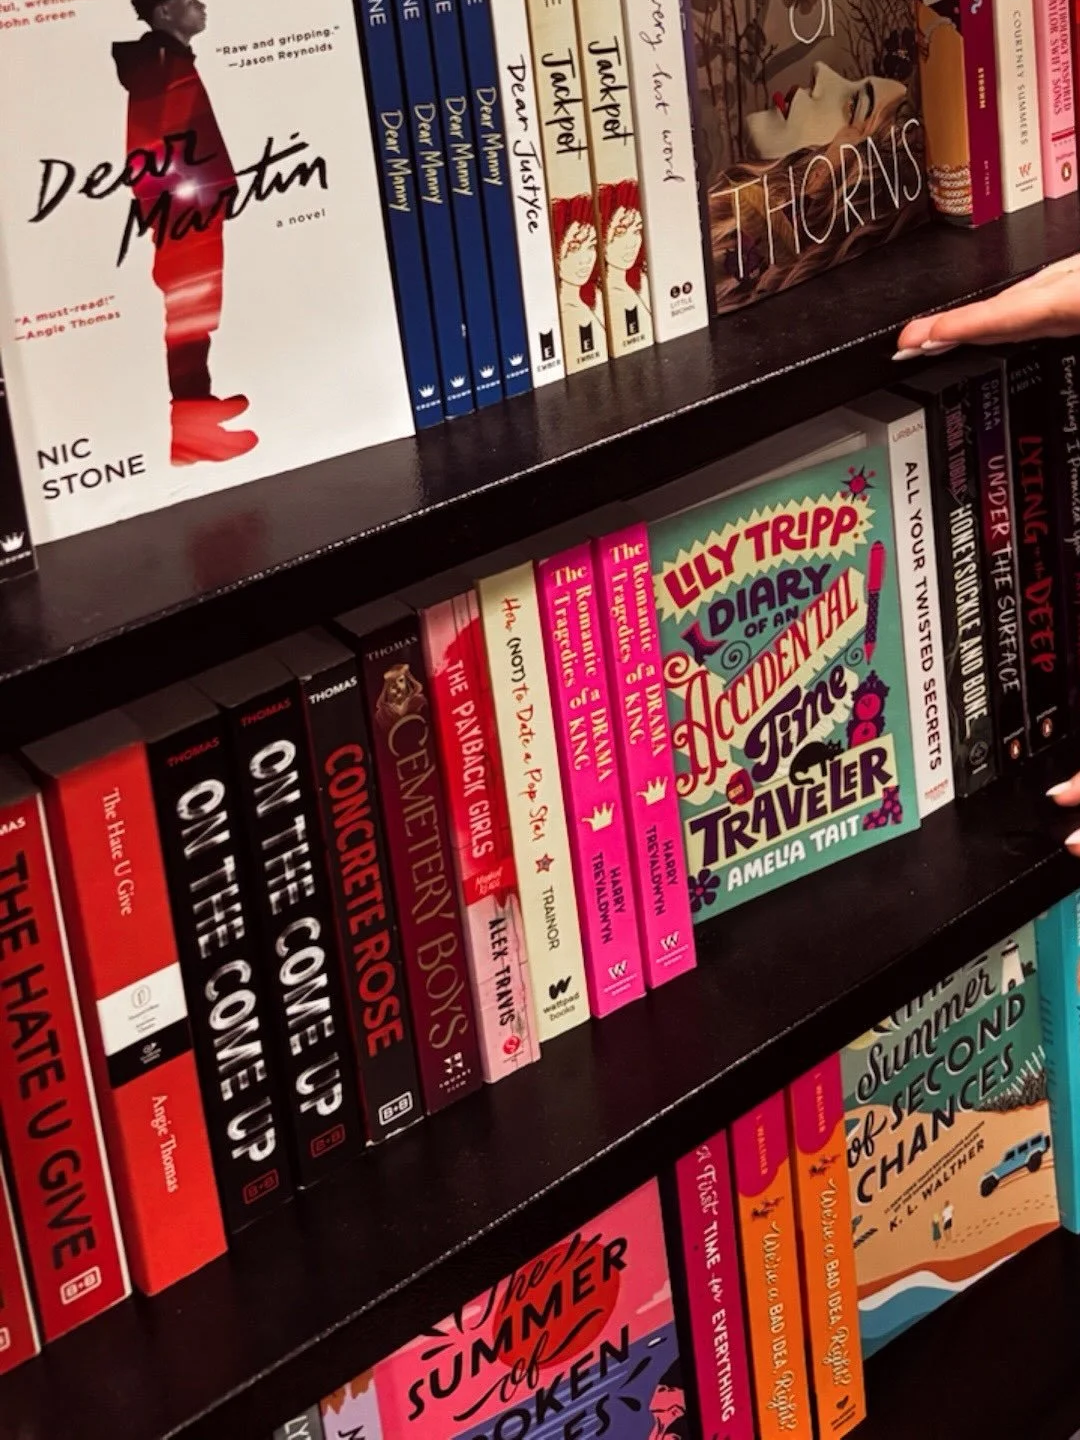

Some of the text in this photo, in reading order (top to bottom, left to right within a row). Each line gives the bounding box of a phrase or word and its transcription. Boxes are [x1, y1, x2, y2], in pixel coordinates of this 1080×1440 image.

[216, 45, 248, 55] "Raw
[252, 39, 274, 49] and
[278, 43, 333, 59] Reynolds
[541, 47, 588, 160] Jackpot
[28, 127, 216, 223] Dear
[507, 54, 542, 233] Dear Justyce
[651, 63, 673, 117] last
[664, 128, 685, 184] word
[116, 131, 328, 268] Martin
[709, 117, 924, 281] THORNS
[37, 438, 92, 470] NIC
[42, 454, 146, 499] STONE
[663, 533, 743, 611] LILY
[708, 563, 832, 638] DIARY
[743, 604, 800, 640] OF AN
[904, 461, 943, 771] ALL YOUR TWISTED SECRETS
[949, 503, 989, 730] HONEYSUCKLE AND BONE
[308, 675, 358, 706] THOMAS
[661, 564, 860, 799] ACCIDENTAL
[743, 662, 851, 783] Time
[689, 742, 896, 870] TRAVELER
[726, 814, 860, 893] AMELIA TAIT
[324, 743, 404, 1058] CONCRETE ROSE
[386, 712, 469, 1051] CEMETERY BOYS
[0, 851, 96, 1271] THE HATE U GIVE
[847, 1110, 888, 1169] of
[889, 993, 1026, 1131] SECOND
[856, 966, 996, 1104] Summer
[856, 1041, 1015, 1207] CHANCES
[408, 1237, 629, 1422] SUMMER
